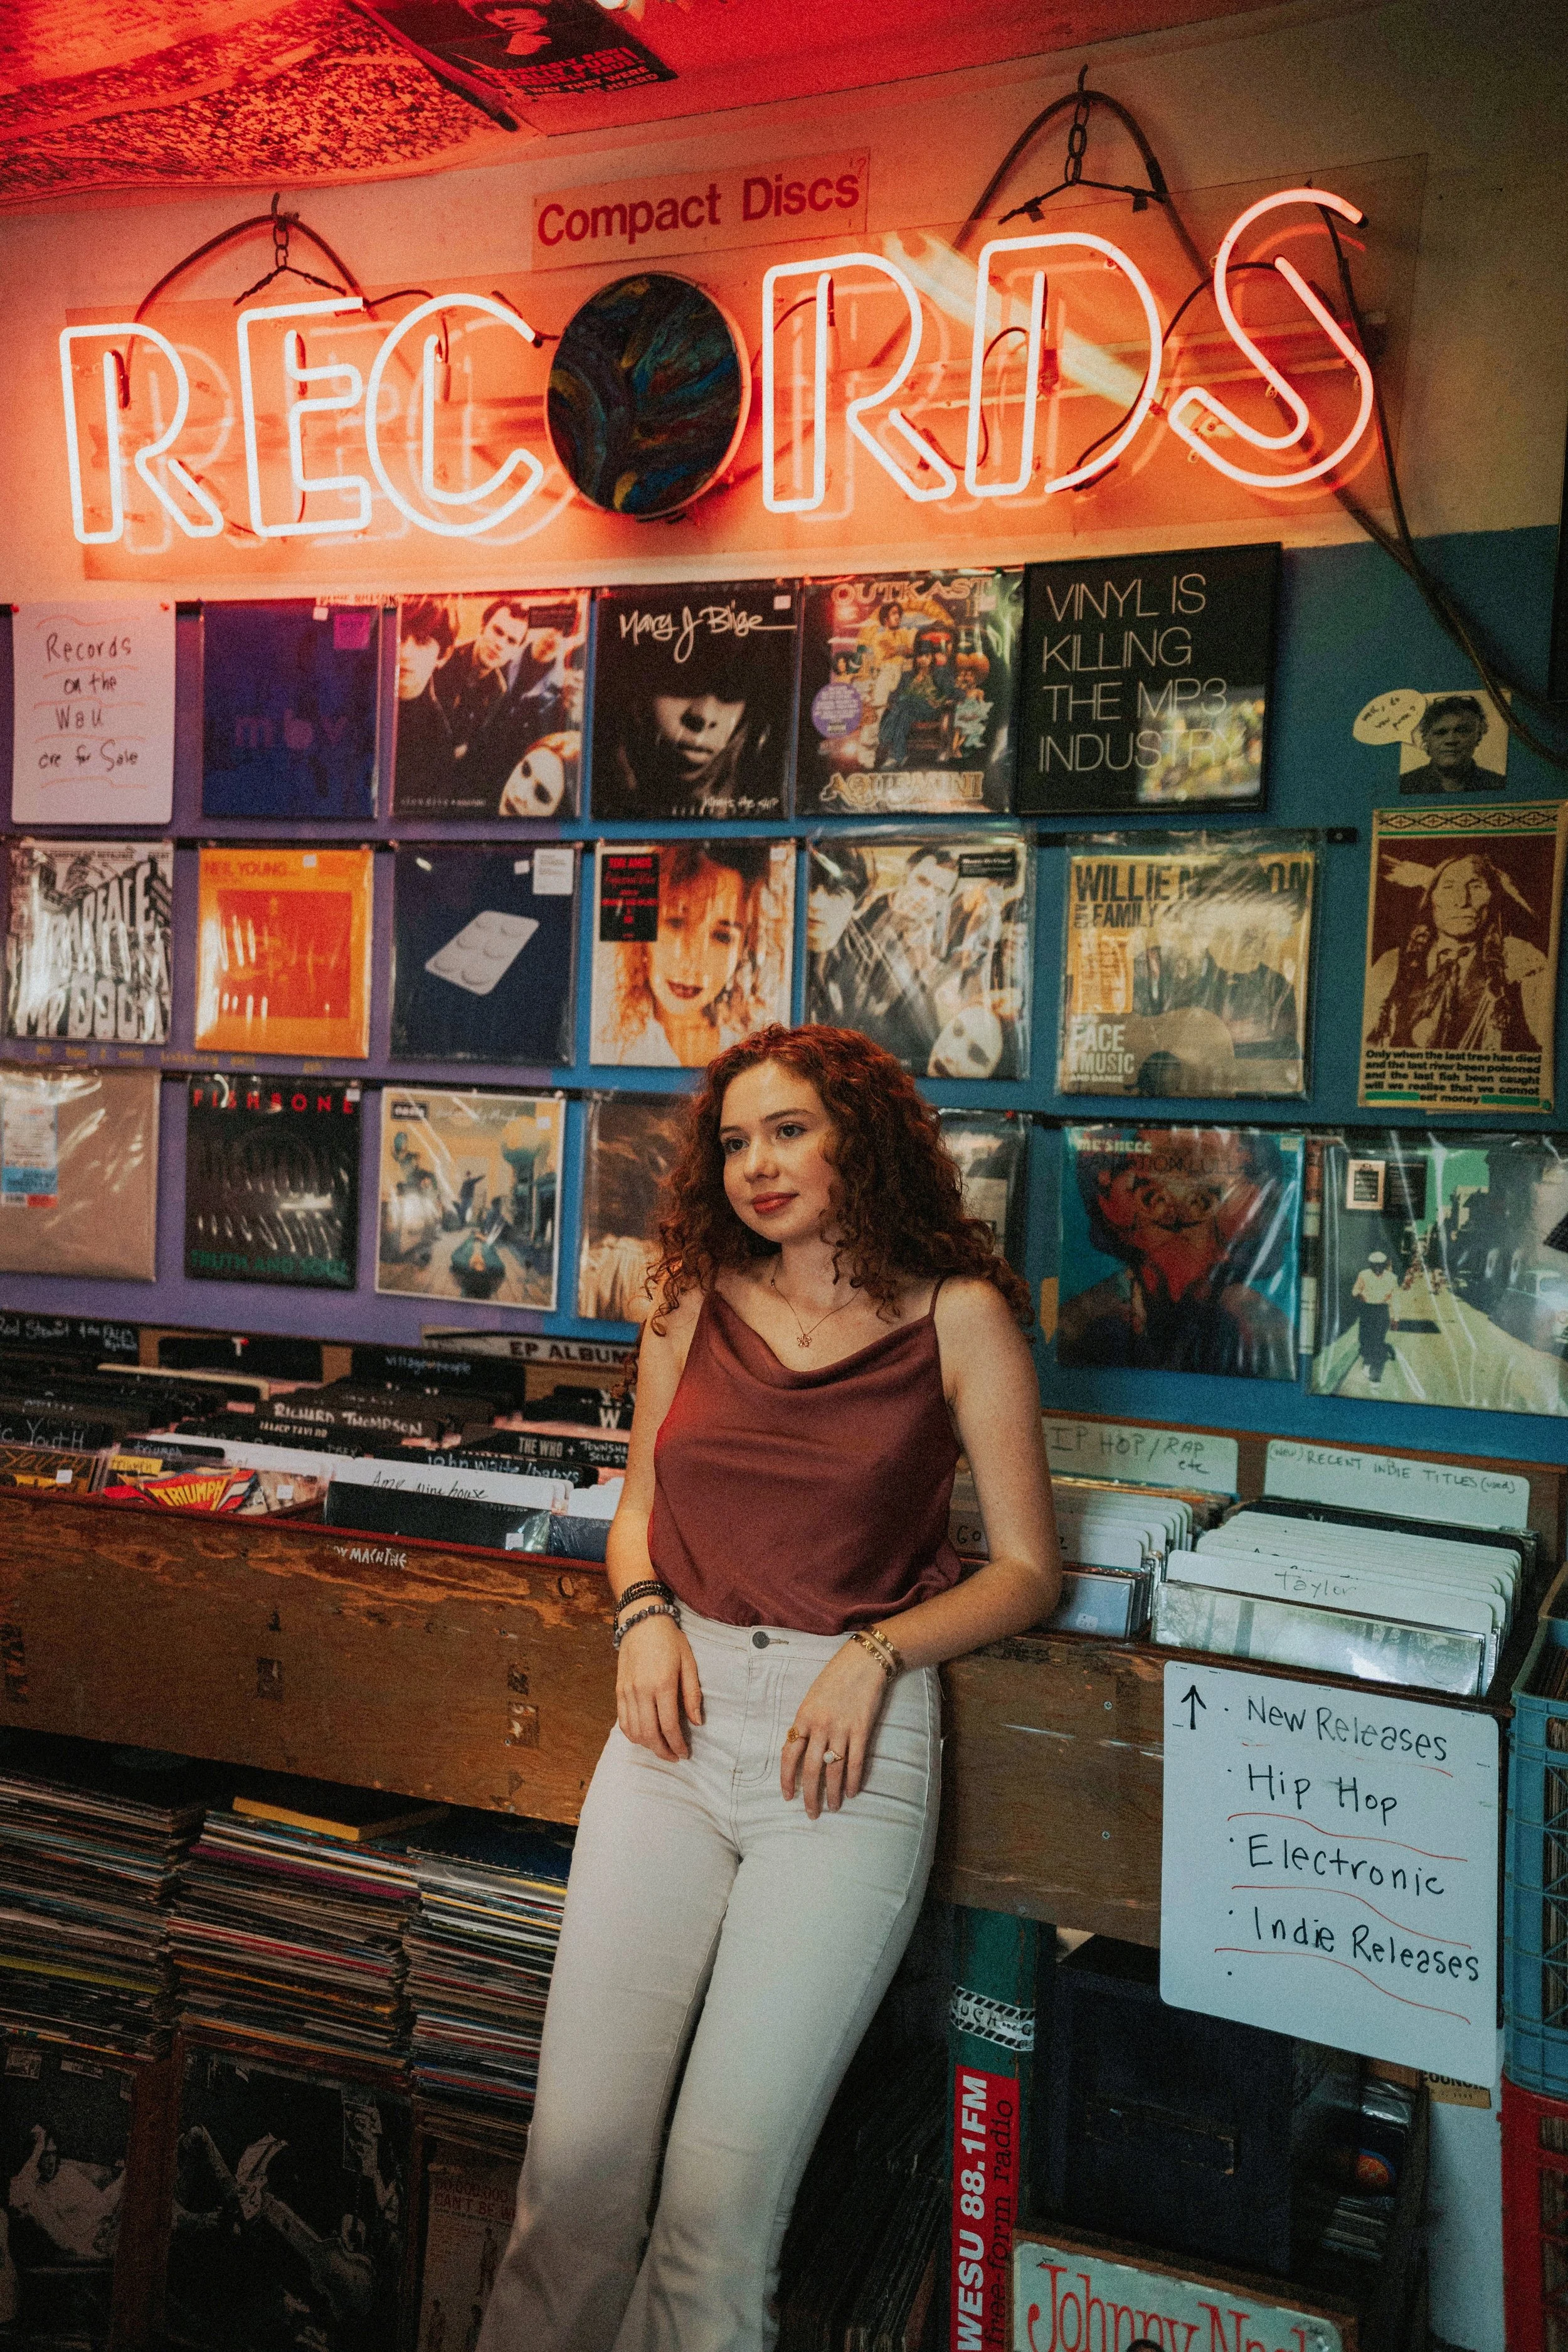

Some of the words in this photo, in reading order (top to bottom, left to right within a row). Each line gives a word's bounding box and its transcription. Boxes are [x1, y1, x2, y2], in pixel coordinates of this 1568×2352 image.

[538, 183, 722, 246] Compact
[742, 174, 860, 222] Discs
[831, 577, 992, 605] OUTKAST
[1046, 578, 1160, 622] VINYL
[1172, 573, 1206, 614] IS
[46, 632, 132, 662] Records
[1042, 627, 1192, 673] KILLING
[64, 677, 82, 694] on
[89, 672, 117, 693] the
[1043, 681, 1123, 723] THE
[1136, 678, 1227, 719] MP3
[100, 739, 139, 772] Sale
[1075, 864, 1170, 902] WILLIE
[1093, 903, 1159, 928] FAMILY
[1071, 1024, 1126, 1053] FACE
[1080, 1053, 1135, 1075] MUSIC
[1365, 1050, 1391, 1060] Only
[1394, 1050, 1424, 1060] when
[1426, 1050, 1443, 1060] the
[1445, 1051, 1466, 1060] last
[1468, 1052, 1491, 1062] tree
[1493, 1052, 1514, 1062] has
[1516, 1053, 1542, 1063] died
[1365, 1061, 1386, 1070] and
[1388, 1061, 1406, 1070] the
[1407, 1062, 1428, 1070] last
[1457, 1063, 1485, 1072] been
[1365, 1072, 1386, 1080] and
[1390, 1072, 1409, 1080] the
[1414, 1072, 1434, 1080] last
[1439, 1072, 1460, 1081] fish
[1465, 1073, 1495, 1083] been
[1500, 1075, 1540, 1086] caught
[1365, 1081, 1384, 1089] will
[1450, 1083, 1473, 1092] that
[1498, 1085, 1540, 1095] cannot
[1420, 1094, 1438, 1102] eat
[1440, 1094, 1481, 1104] money
[509, 1341, 539, 1357] EP
[549, 1344, 634, 1365] ALBUM
[518, 1437, 537, 1455] THE
[539, 1440, 563, 1458] WHO
[580, 1440, 628, 1454] TOWNSHE
[1050, 1425, 1088, 1451] IP
[1307, 1453, 1362, 1470] RECENT
[148, 1477, 228, 1511] TRIUMPH
[1274, 1569, 1357, 1599] Taylor
[1247, 1695, 1307, 1733] New
[1316, 1706, 1448, 1762] Releases
[1248, 1763, 1311, 1810] Hip
[1338, 1776, 1398, 1826] Hop
[1248, 1833, 1445, 1897] Electronic
[1254, 1906, 1335, 1953] Indie
[1352, 1924, 1480, 1982] Releases
[990, 2099, 1013, 2182] radio
[956, 2228, 985, 2352] WESU
